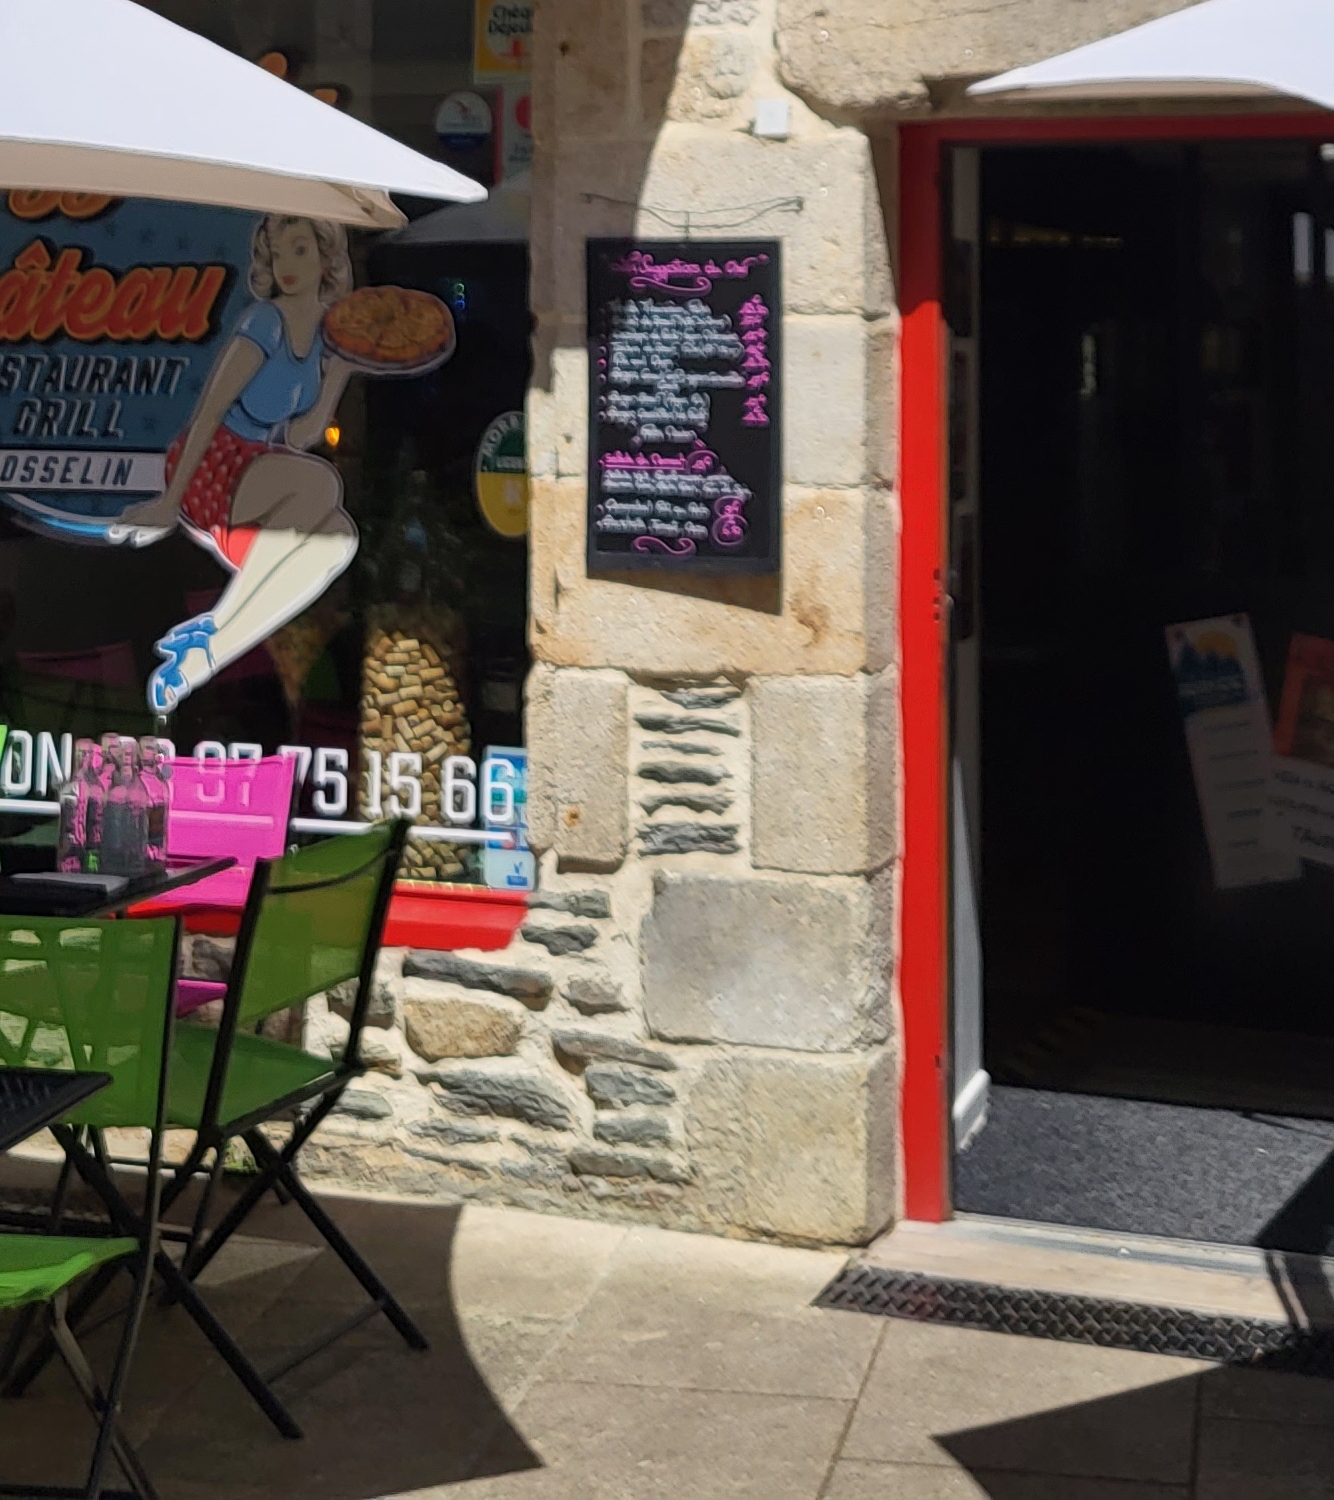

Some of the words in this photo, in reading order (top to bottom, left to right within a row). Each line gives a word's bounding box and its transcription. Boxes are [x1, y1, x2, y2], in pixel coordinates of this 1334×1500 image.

[12, 398, 126, 440] GRILL
[365, 751, 423, 820] 15
[441, 755, 517, 825] 66
